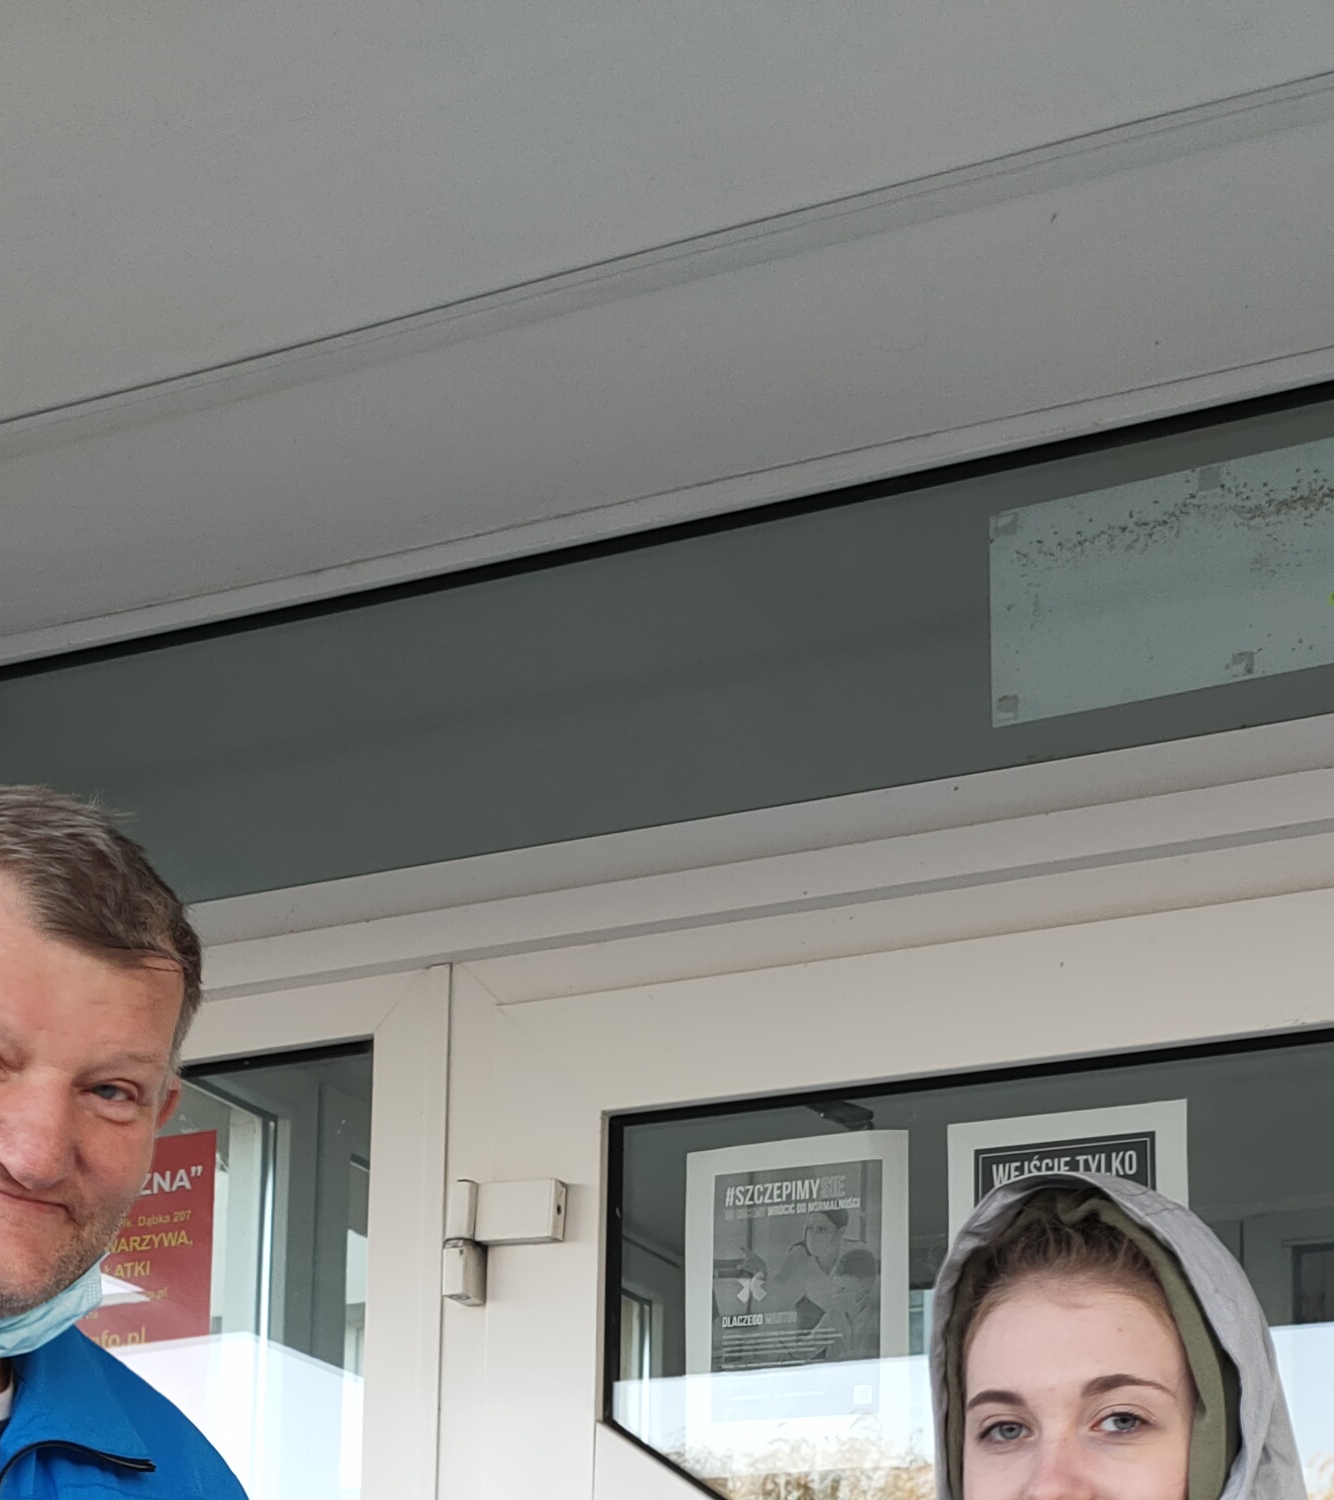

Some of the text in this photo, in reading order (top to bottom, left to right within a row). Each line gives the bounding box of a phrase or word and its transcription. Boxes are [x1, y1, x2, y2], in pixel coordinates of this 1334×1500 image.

[1075, 1150, 1137, 1176] TYLKO
[173, 1210, 192, 1222] 207
[722, 1313, 763, 1328] DLACZEGO
